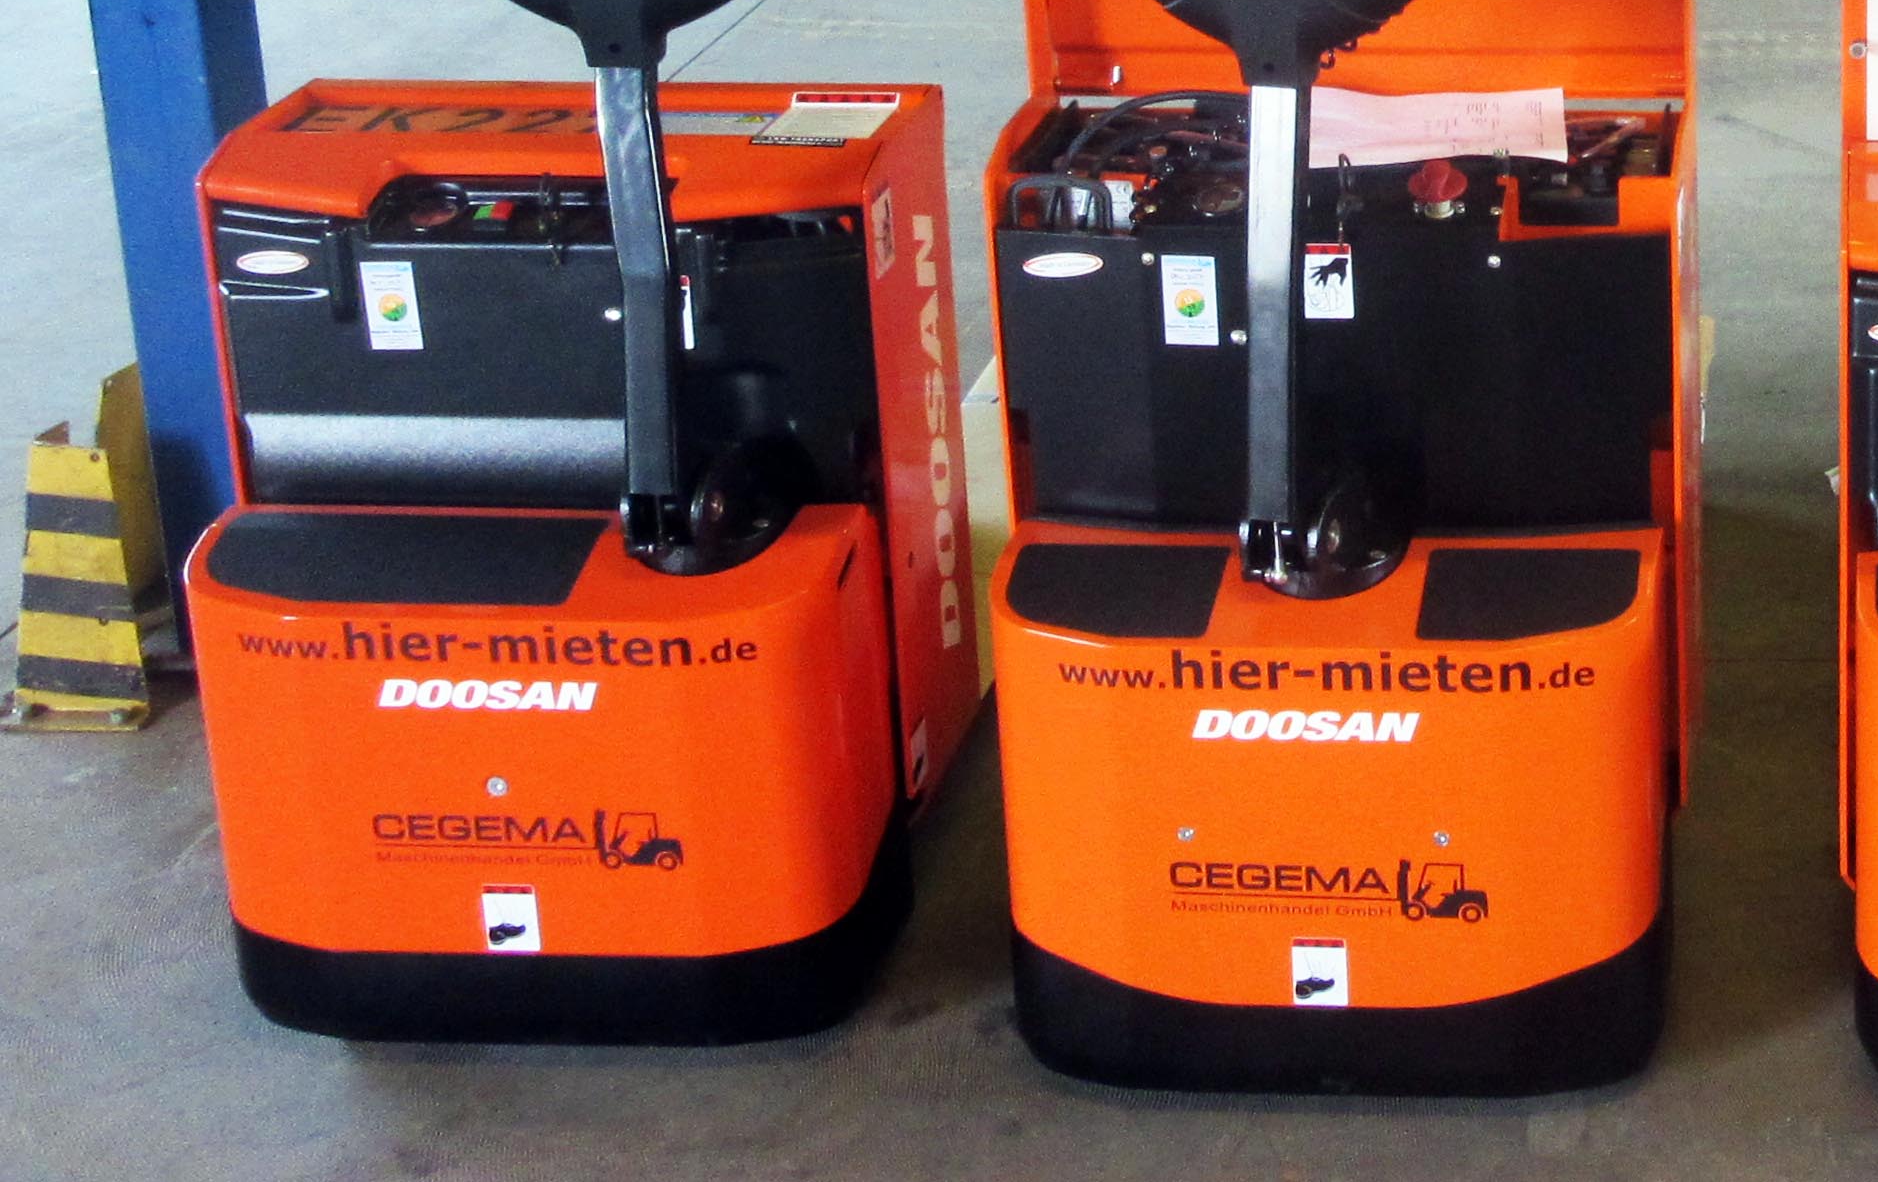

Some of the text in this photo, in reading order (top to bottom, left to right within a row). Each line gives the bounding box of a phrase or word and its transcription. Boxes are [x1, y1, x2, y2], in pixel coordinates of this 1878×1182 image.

[281, 105, 598, 134] EK22
[912, 215, 961, 650] DOOSAN
[237, 621, 758, 667] www.hier-mieten.de
[1058, 649, 1596, 693] www.hier-mieten.de
[377, 678, 597, 711] DOOSAN
[1191, 708, 1420, 743] DOOSAN
[371, 813, 587, 843] CEGEMA
[1169, 860, 1390, 895] CEGEMA
[1170, 899, 1393, 918] Maschinenhandel GmbH
